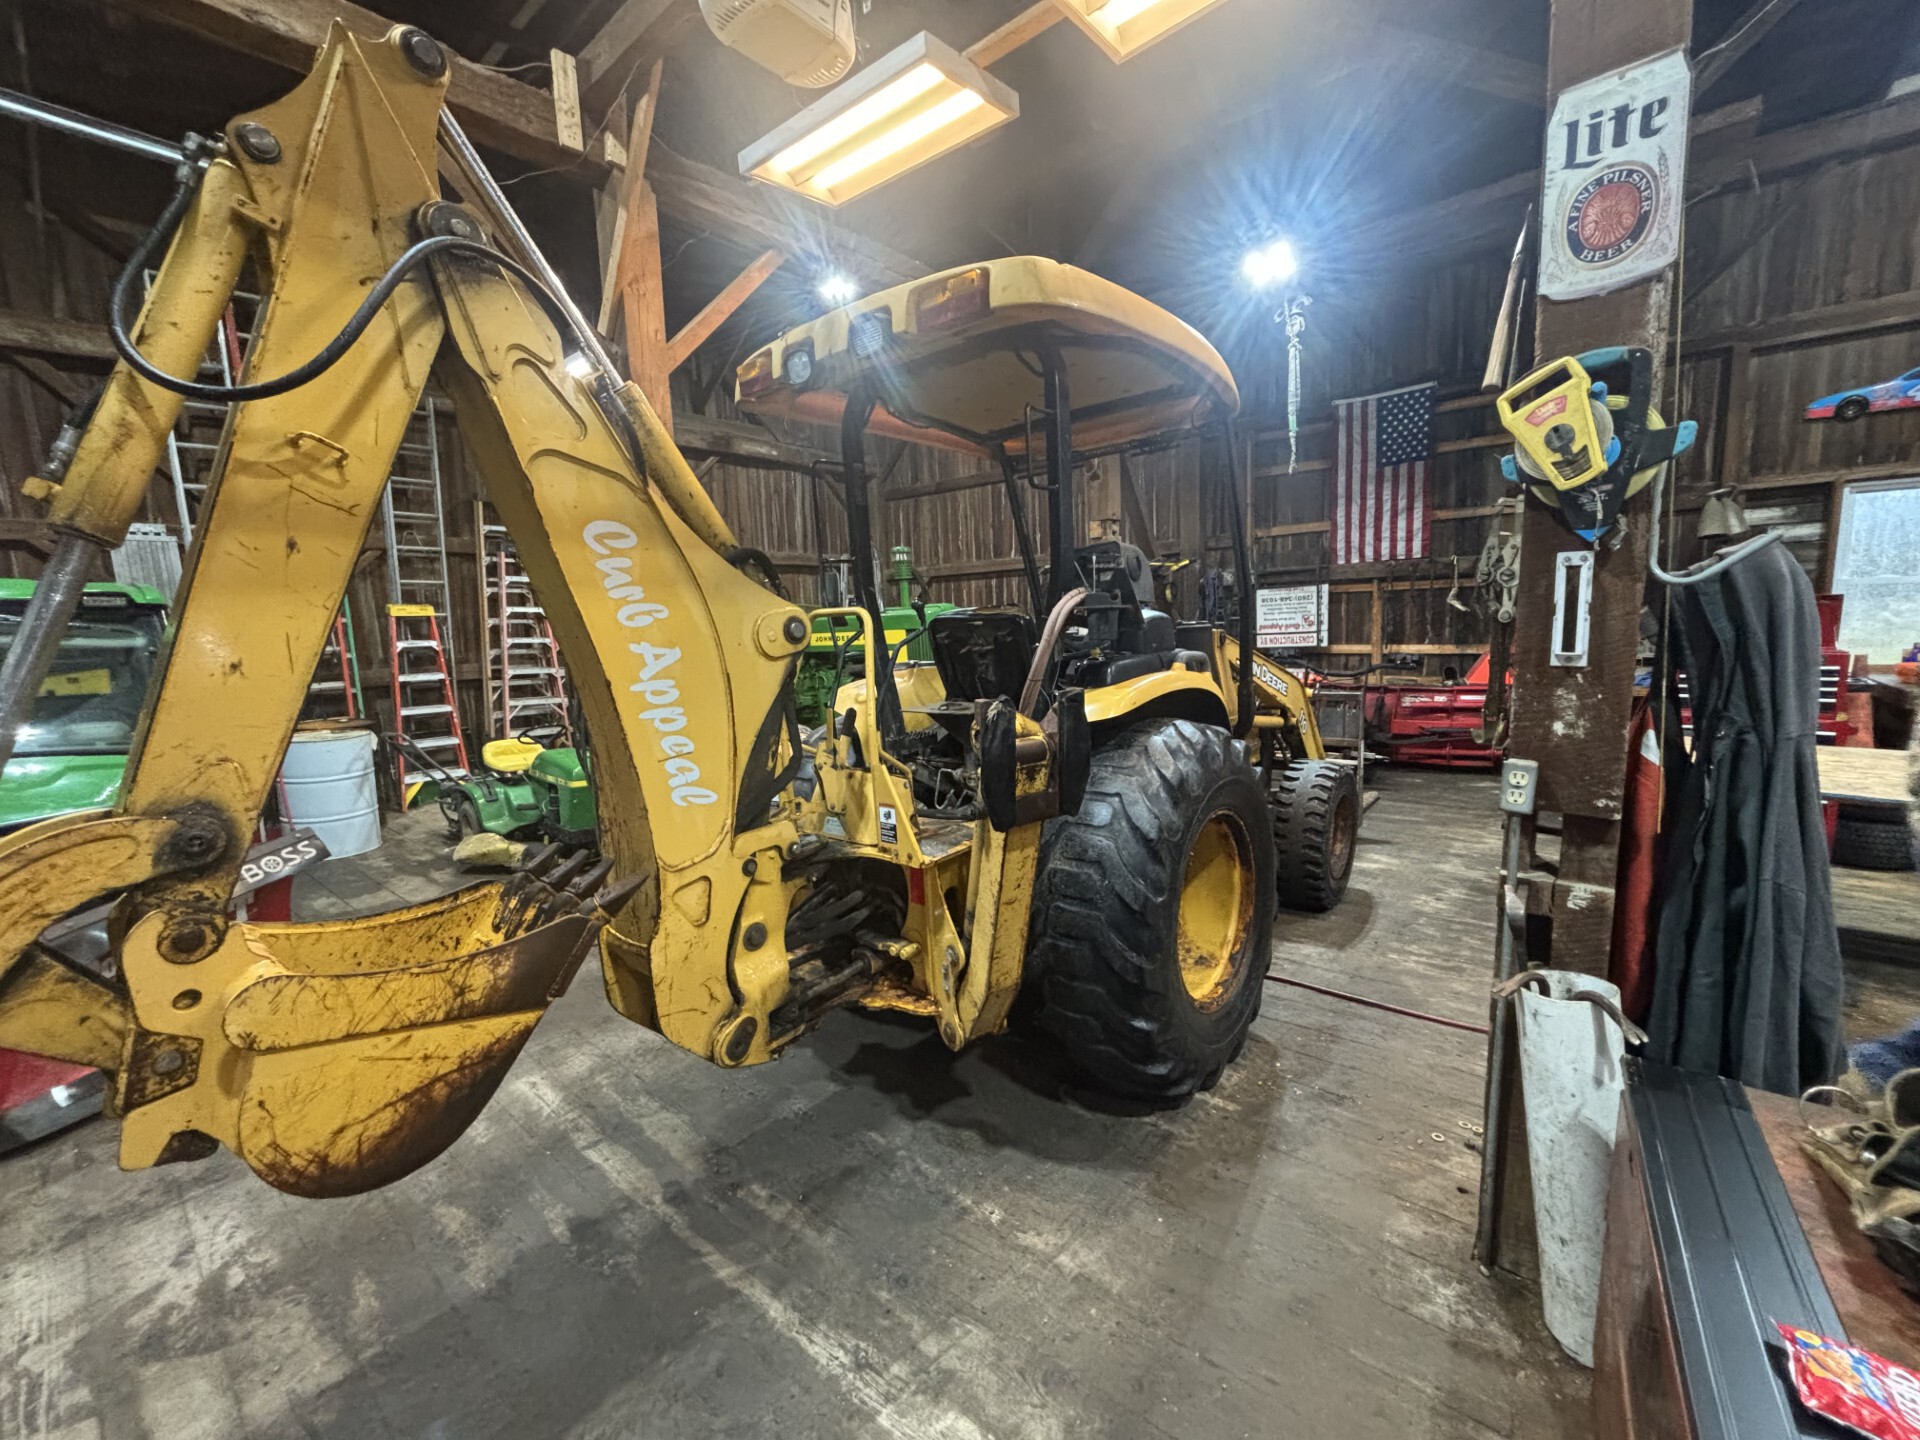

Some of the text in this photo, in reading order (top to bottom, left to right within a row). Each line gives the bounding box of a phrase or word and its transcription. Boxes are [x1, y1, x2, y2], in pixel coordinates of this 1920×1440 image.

[1561, 97, 1668, 169] Lite
[1568, 170, 1651, 232] A FINE PILSNER
[1580, 239, 1633, 261] BEER
[1260, 637, 1269, 645] BY
[1269, 635, 1314, 645] CONSTRUCTION
[582, 520, 718, 807] Curb Appeal
[1261, 664, 1288, 697] DEERE
[241, 840, 317, 883] BOSS
